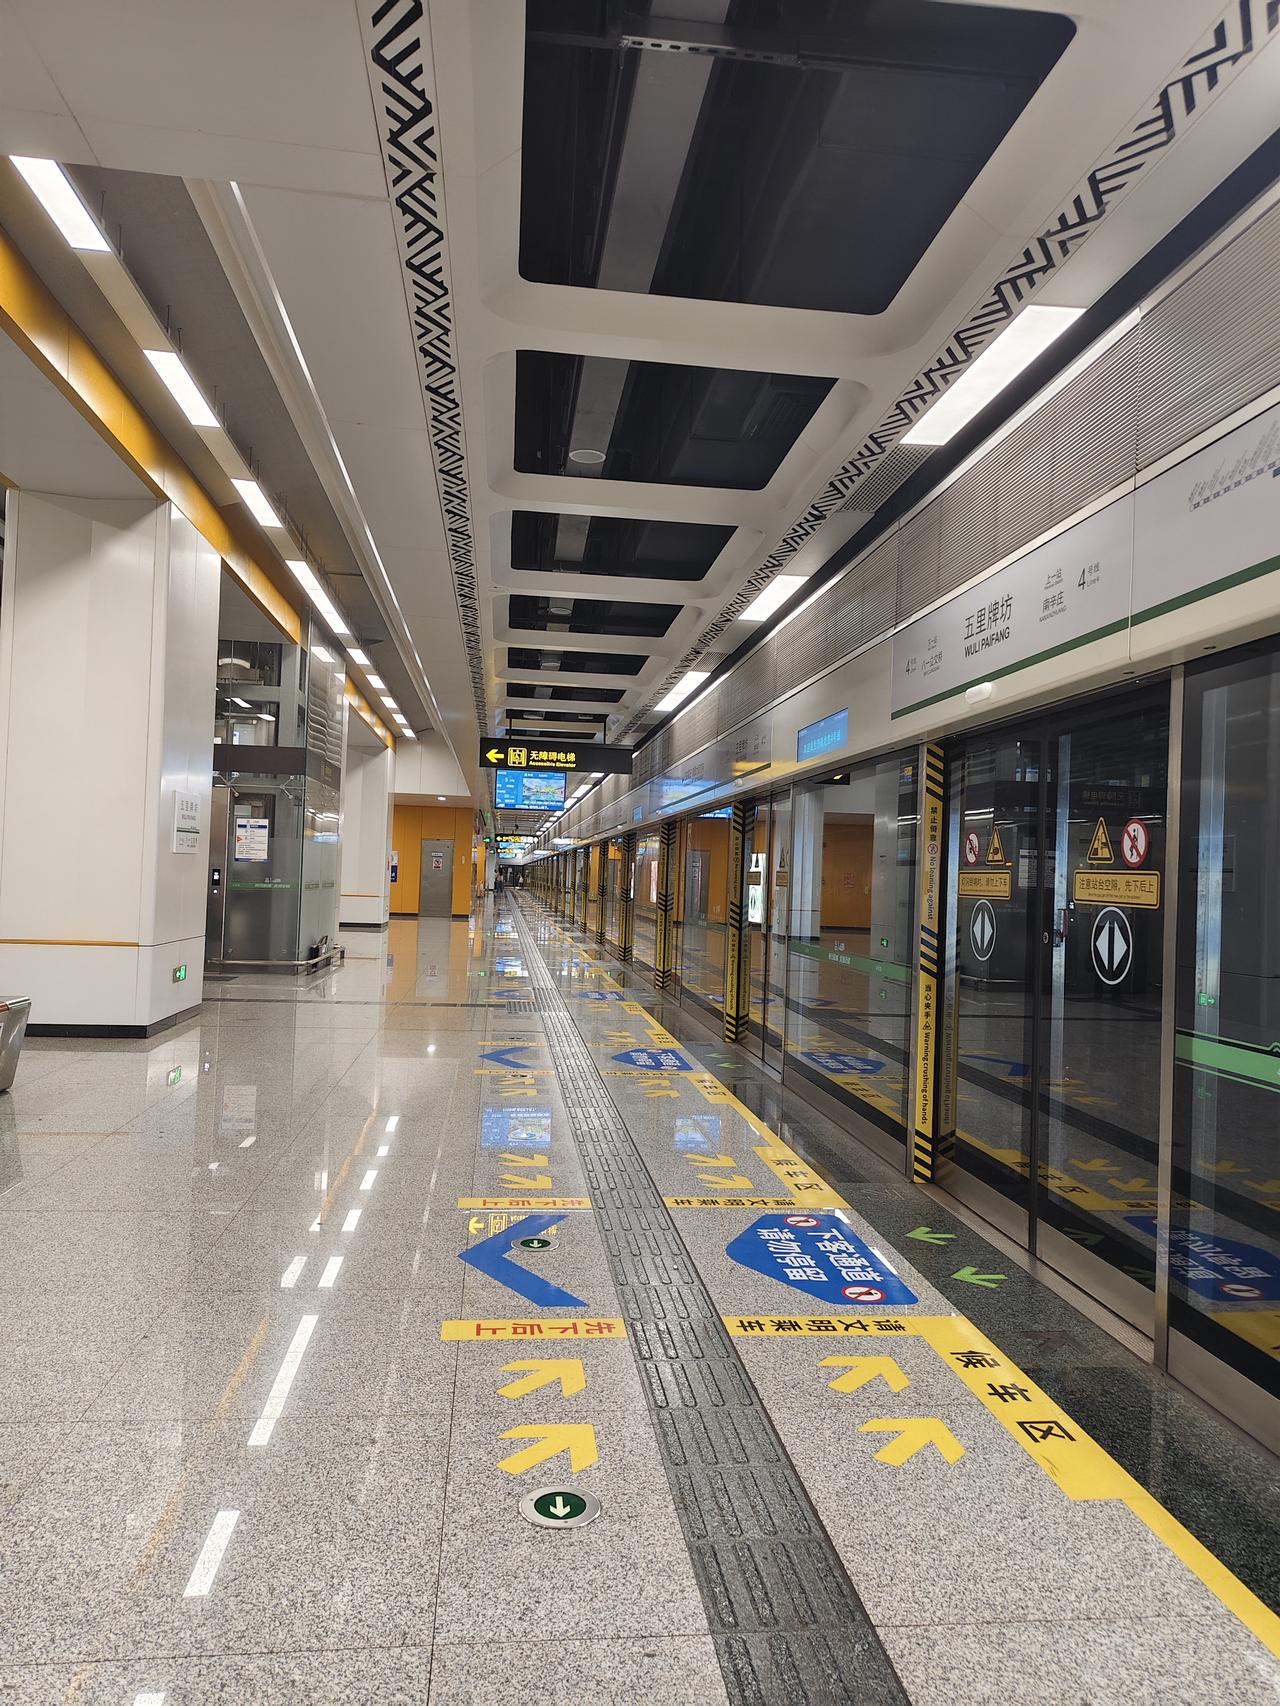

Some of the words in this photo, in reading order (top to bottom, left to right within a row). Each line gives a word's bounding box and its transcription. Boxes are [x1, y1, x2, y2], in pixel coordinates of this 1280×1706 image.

[1077, 567, 1086, 590] 4
[964, 593, 1013, 640] 五里牌坊
[964, 640, 981, 658] WULI
[981, 626, 1010, 651] PAIFANG
[528, 760, 556, 768] Accessible
[529, 750, 576, 762] 无障碍电梯
[929, 856, 937, 867] No
[928, 867, 936, 895] leaning
[924, 984, 932, 1019] 当心夹手
[922, 1032, 931, 1062] Warning
[921, 1062, 929, 1094] crushing
[922, 1094, 929, 1103] of
[756, 1228, 830, 1283] 请勿停留
[807, 1228, 884, 1283] 下客通道
[475, 1321, 616, 1337] 先下后上
[736, 1318, 907, 1333] 请文明乘车
[949, 1350, 1077, 1443] 候车区
